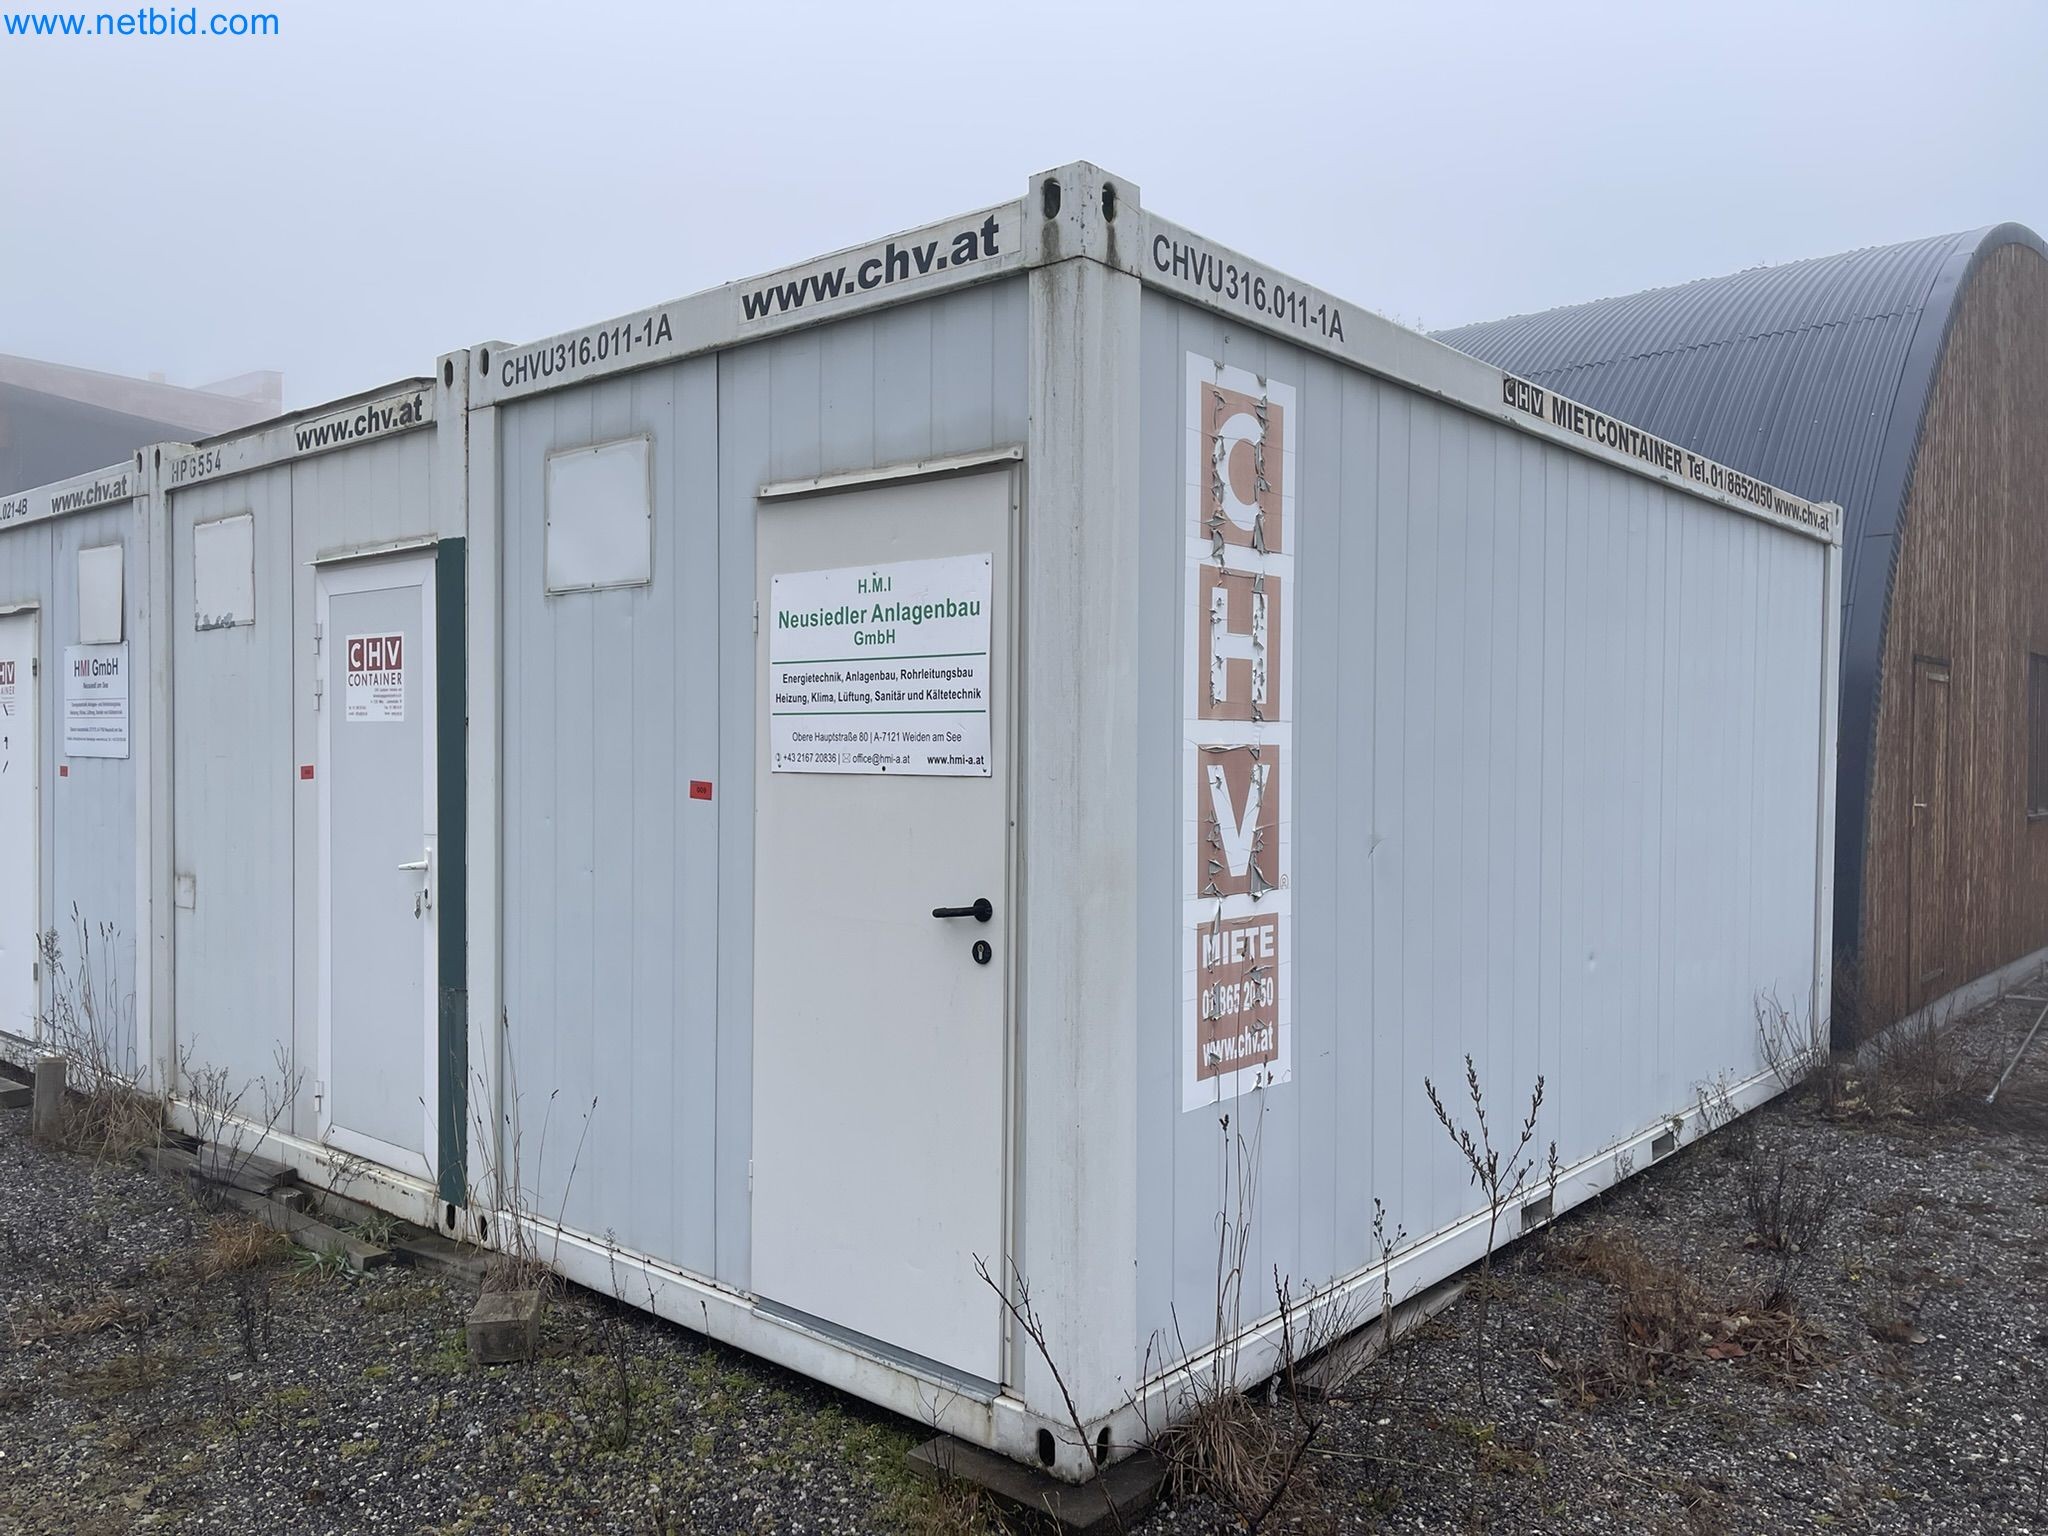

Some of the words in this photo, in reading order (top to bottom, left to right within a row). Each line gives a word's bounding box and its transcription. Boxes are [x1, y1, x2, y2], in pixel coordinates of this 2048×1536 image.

[742, 214, 999, 320] www.chv.at
[1153, 234, 1344, 343] CHVU316.011-1A
[502, 313, 672, 387] CHVU316.011-1A
[296, 393, 423, 451] www.chv.at
[1552, 396, 1682, 475] MIETCONTAINER
[1687, 454, 1709, 484] Tel.
[1711, 465, 1772, 509] 01/8652050
[1774, 497, 1829, 531] www.chv.at
[51, 475, 127, 513] www.chv.at
[778, 606, 867, 629] Neusiedler
[871, 598, 981, 625] Anlagenbau
[854, 629, 896, 646] GmbH
[74, 659, 90, 677] HMI
[92, 657, 118, 676] GmbH
[350, 641, 400, 668] CHV
[348, 673, 402, 687] CONTAINER
[782, 671, 844, 685] Energietechnik,
[845, 669, 898, 683] Anlagenbau,
[900, 667, 974, 681] Rohrleitungsbau
[775, 692, 809, 705] Heizung,
[811, 692, 834, 704] Klima,
[837, 691, 873, 704] Lüftung,
[874, 690, 905, 702] Sanitär
[907, 690, 924, 701] und
[926, 688, 982, 701] Kältetechnik
[792, 732, 813, 742] Obere
[814, 732, 857, 745] Hauptstraße
[859, 732, 869, 742] 80
[874, 731, 900, 742] A-7121
[902, 732, 930, 742] Weiden
[932, 734, 944, 742] am
[946, 732, 962, 742] See
[783, 753, 796, 763] +43
[797, 753, 814, 763] 2167
[852, 754, 910, 766] office@hmi-a.at
[927, 755, 984, 765] www.hmi-a.at
[1203, 925, 1274, 969] MIETE
[1203, 1020, 1273, 1066] www.chv.at
